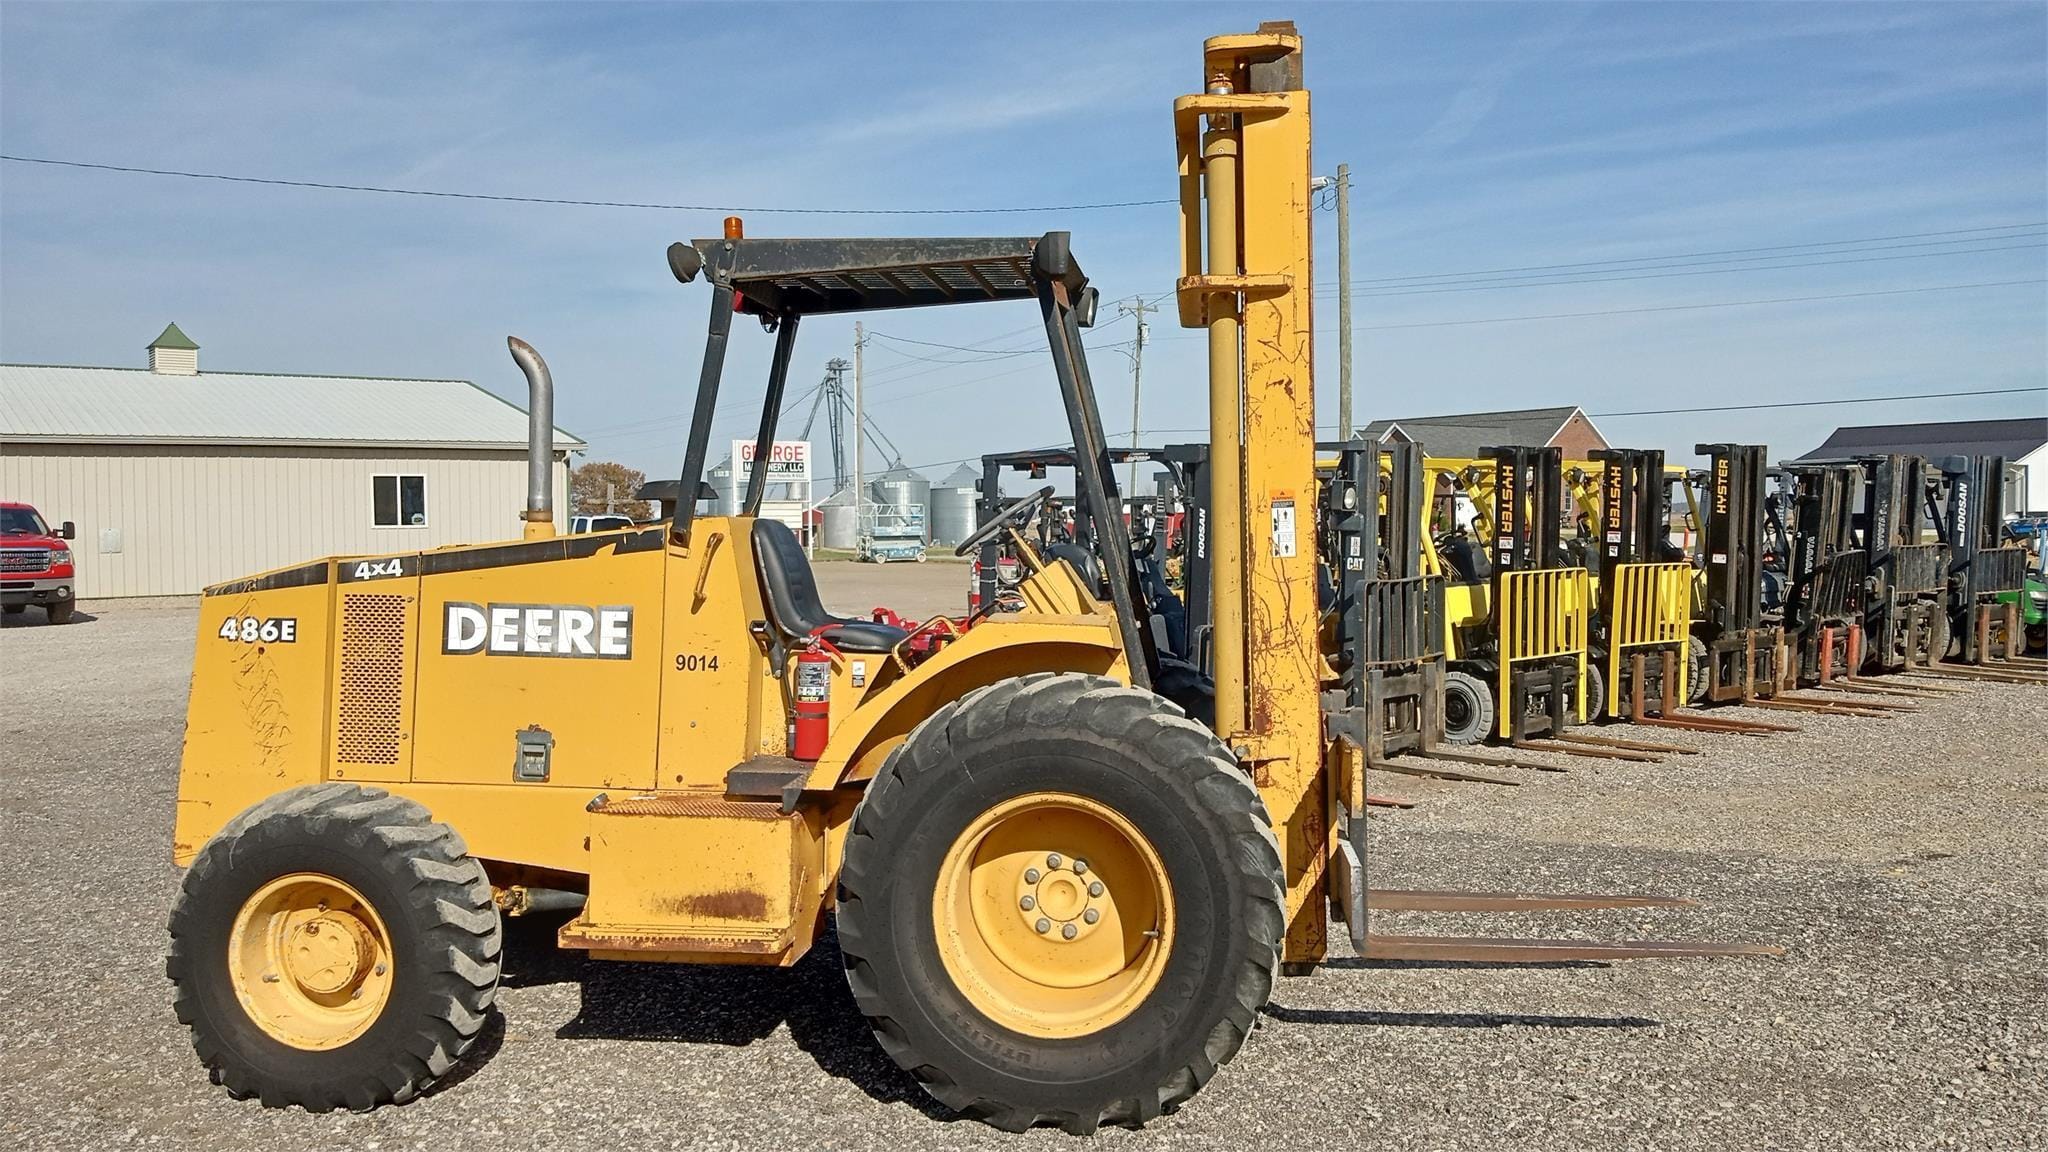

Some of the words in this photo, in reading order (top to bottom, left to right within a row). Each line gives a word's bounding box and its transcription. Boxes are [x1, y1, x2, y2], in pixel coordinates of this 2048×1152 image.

[742, 445, 803, 461] GRGE
[789, 463, 803, 472] LLC
[1501, 465, 1513, 533] HYSTER
[1609, 466, 1621, 528] HYSTER
[1717, 459, 1728, 514] HYSTER
[1957, 483, 1968, 533] DOOSAN
[1198, 507, 1206, 559] DOOSAN
[355, 559, 403, 580] 4x4
[1346, 557, 1365, 570] CAT
[1804, 536, 1816, 574] TOYOTA
[219, 618, 295, 642] 486E
[447, 606, 629, 655] DEERE
[675, 654, 719, 672] 9014
